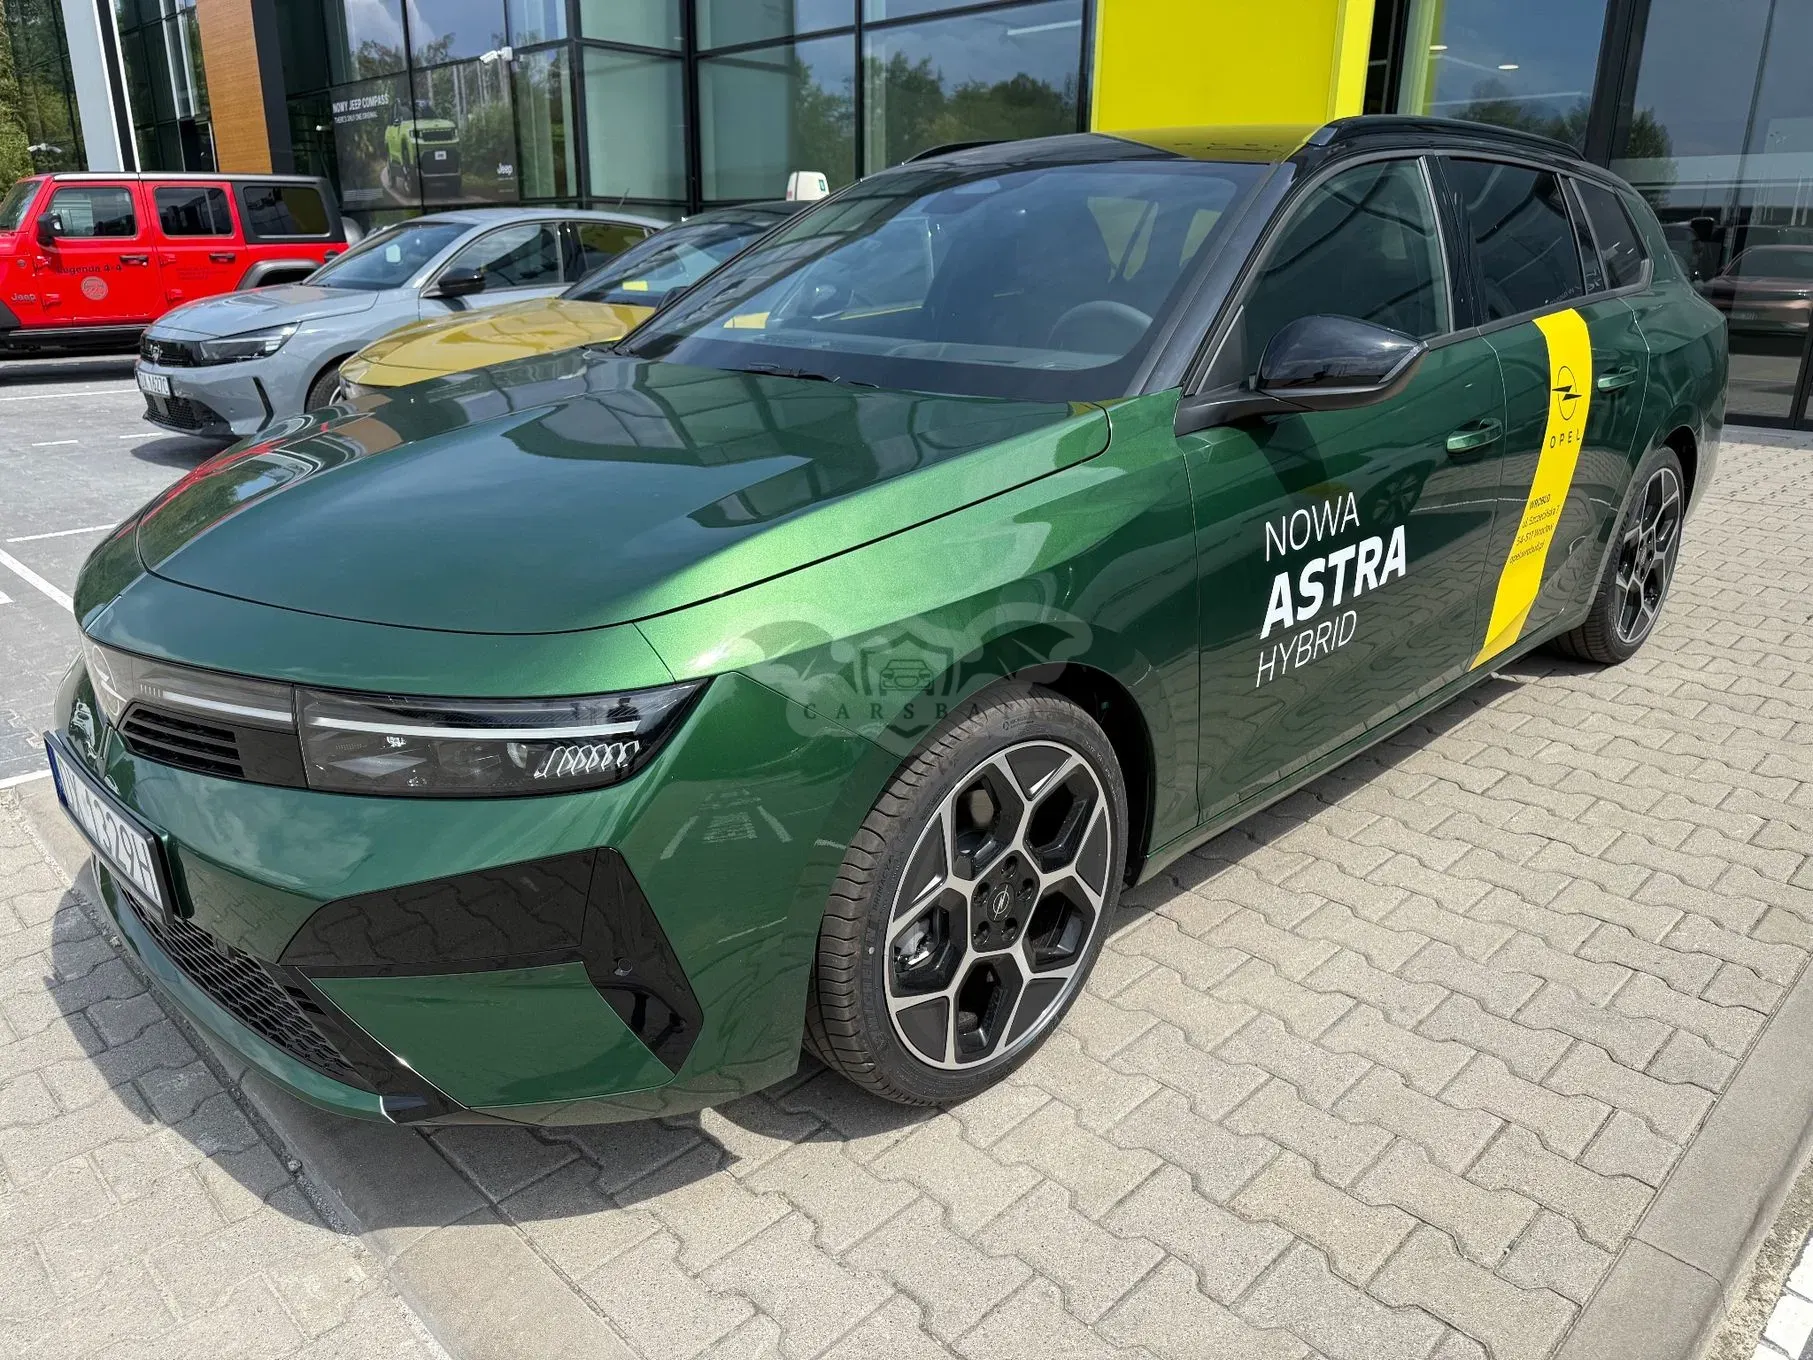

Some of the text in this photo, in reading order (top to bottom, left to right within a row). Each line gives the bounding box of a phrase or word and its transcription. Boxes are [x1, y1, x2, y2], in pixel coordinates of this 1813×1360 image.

[349, 98, 361, 110] JEEP
[362, 93, 389, 108] COMPASS
[497, 163, 513, 175] Jeep
[11, 293, 36, 301] Jeep
[1550, 429, 1580, 449] OPEL
[1265, 492, 1360, 562] NOWA
[1260, 524, 1406, 640] ASTRA
[1255, 610, 1357, 688] HYBRID
